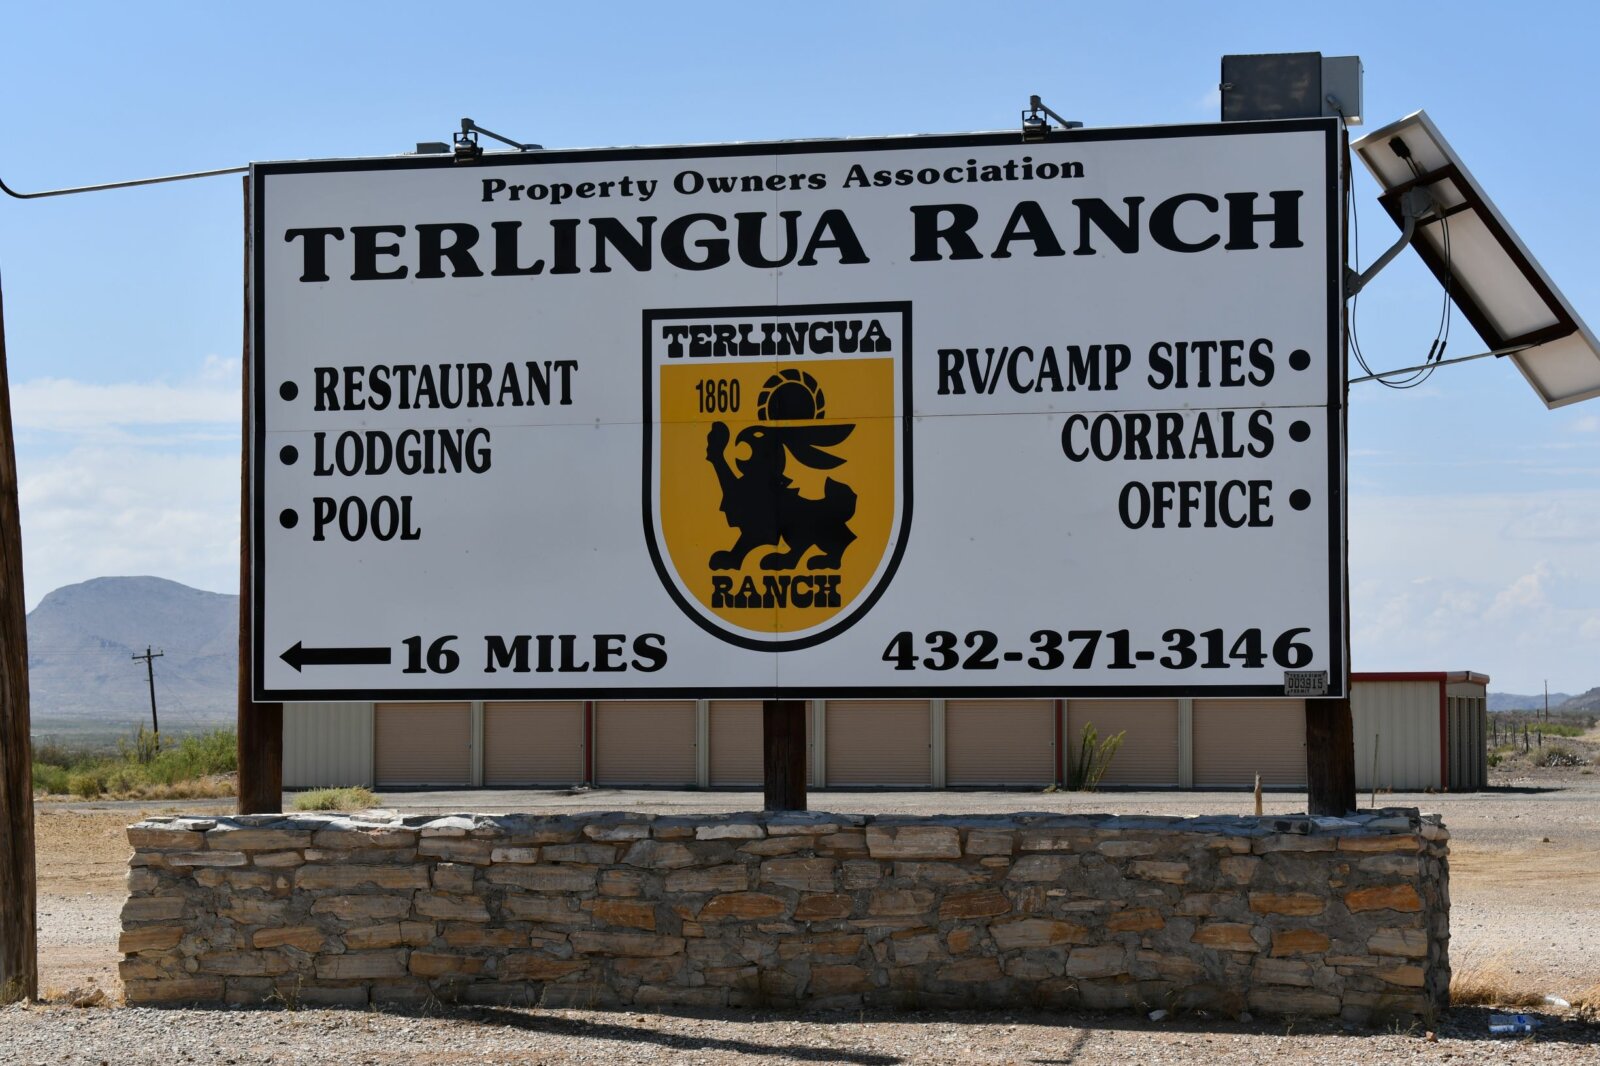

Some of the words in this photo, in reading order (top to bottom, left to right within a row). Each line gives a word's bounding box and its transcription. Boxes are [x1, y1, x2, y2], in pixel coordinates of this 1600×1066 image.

[481, 174, 658, 205] Property
[673, 170, 827, 195] Owners
[842, 156, 1085, 189] Association
[284, 208, 871, 283] TERLINGUA
[909, 189, 1304, 262] RANCH
[662, 319, 892, 359] TERLINGUA
[313, 359, 579, 412] RESTAURANT
[937, 343, 1132, 396] RV/CAMP
[1147, 337, 1275, 391] SITES
[695, 378, 741, 414] 1860
[313, 427, 492, 477] LODGING
[1061, 409, 1275, 463] CORRALS
[312, 495, 422, 542] POOL
[1118, 479, 1274, 530] OFFICE
[710, 574, 842, 609] RANCH
[401, 635, 460, 674] 16
[483, 633, 668, 673] MILES
[881, 627, 1314, 671] 432-371-3146
[1288, 677, 1323, 689] 003915
